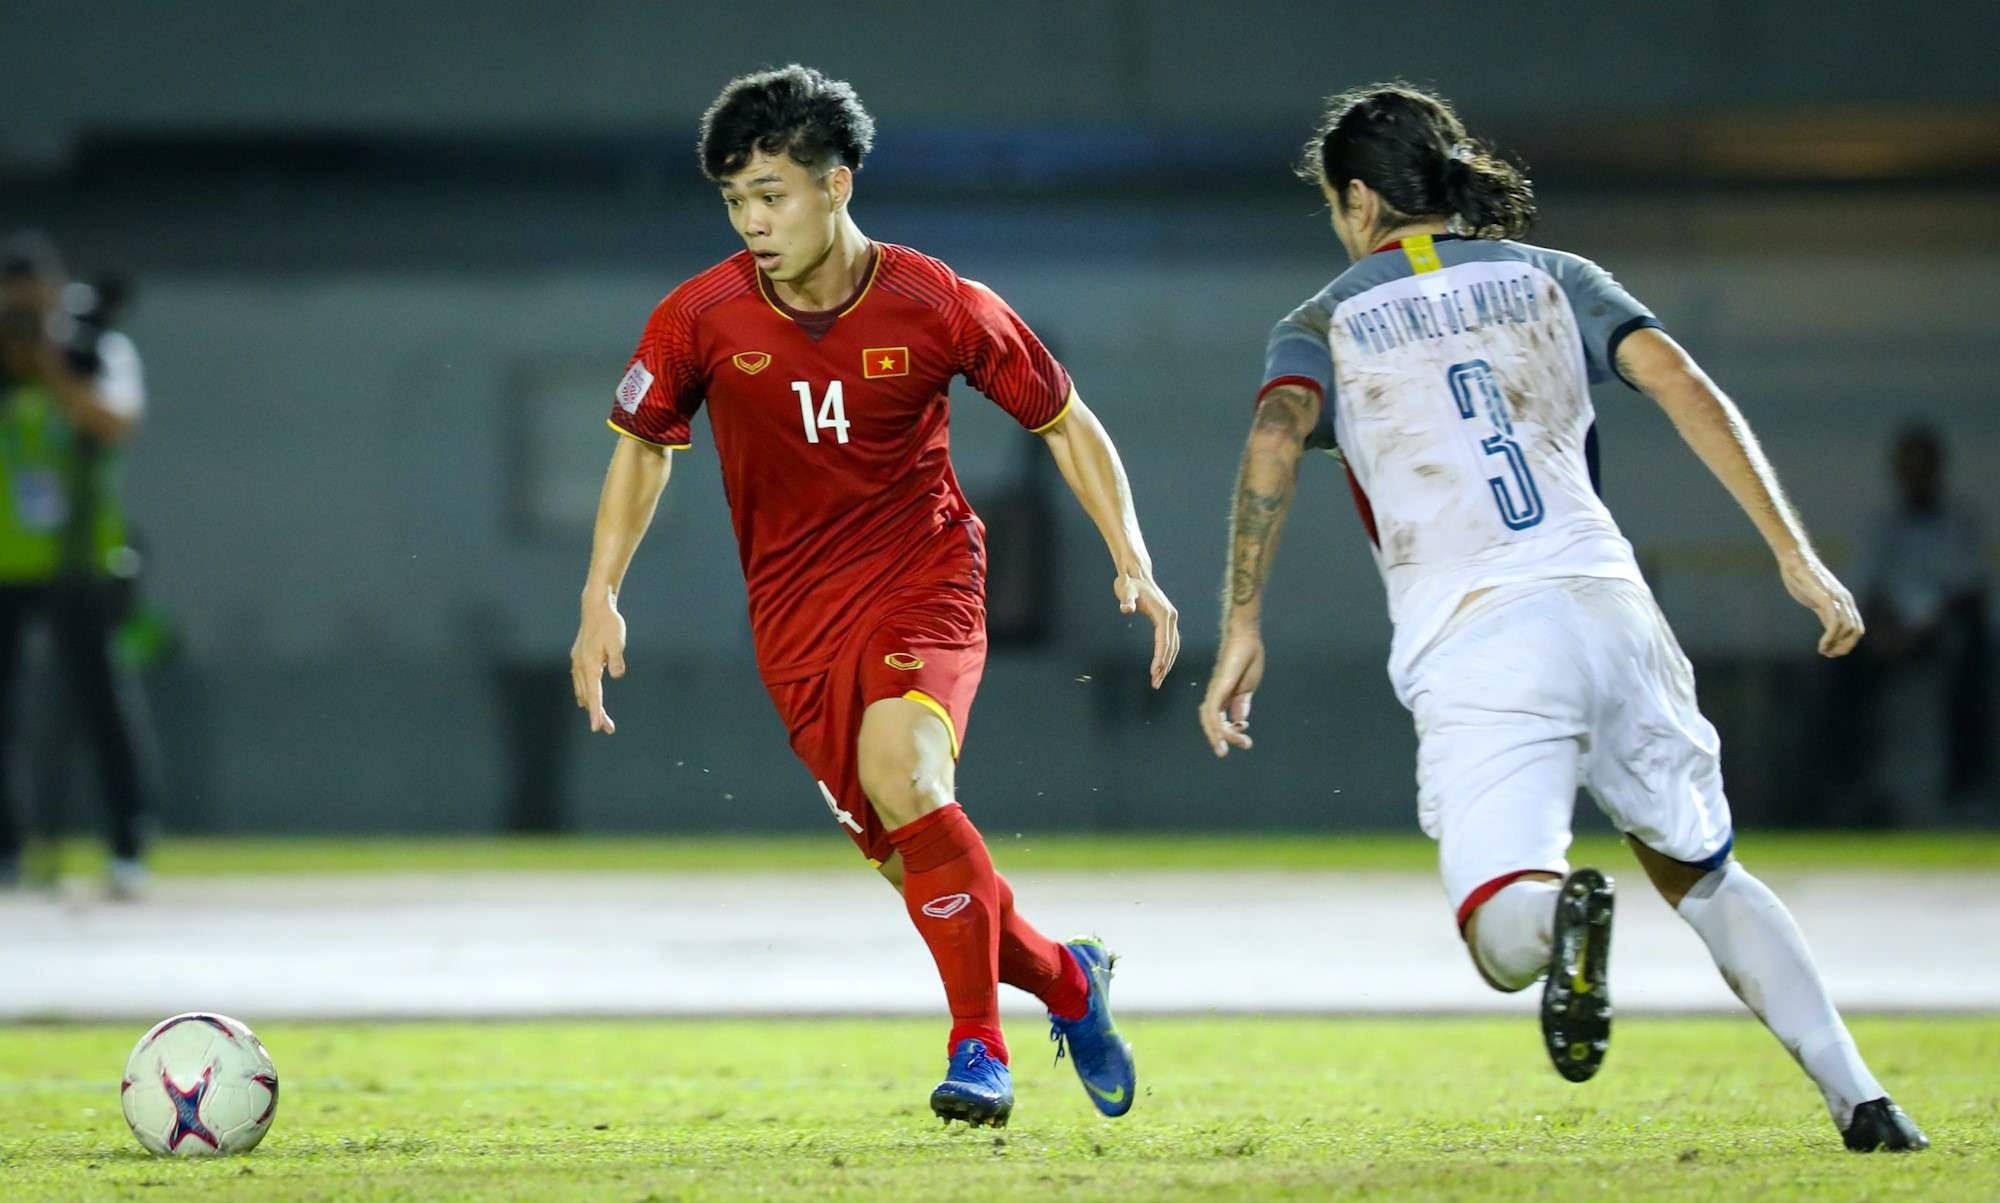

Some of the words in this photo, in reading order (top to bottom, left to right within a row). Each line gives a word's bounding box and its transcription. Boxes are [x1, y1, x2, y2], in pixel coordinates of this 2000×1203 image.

[1440, 290, 1475, 335] DE
[790, 379, 851, 445] 14
[1447, 358, 1545, 531] 3
